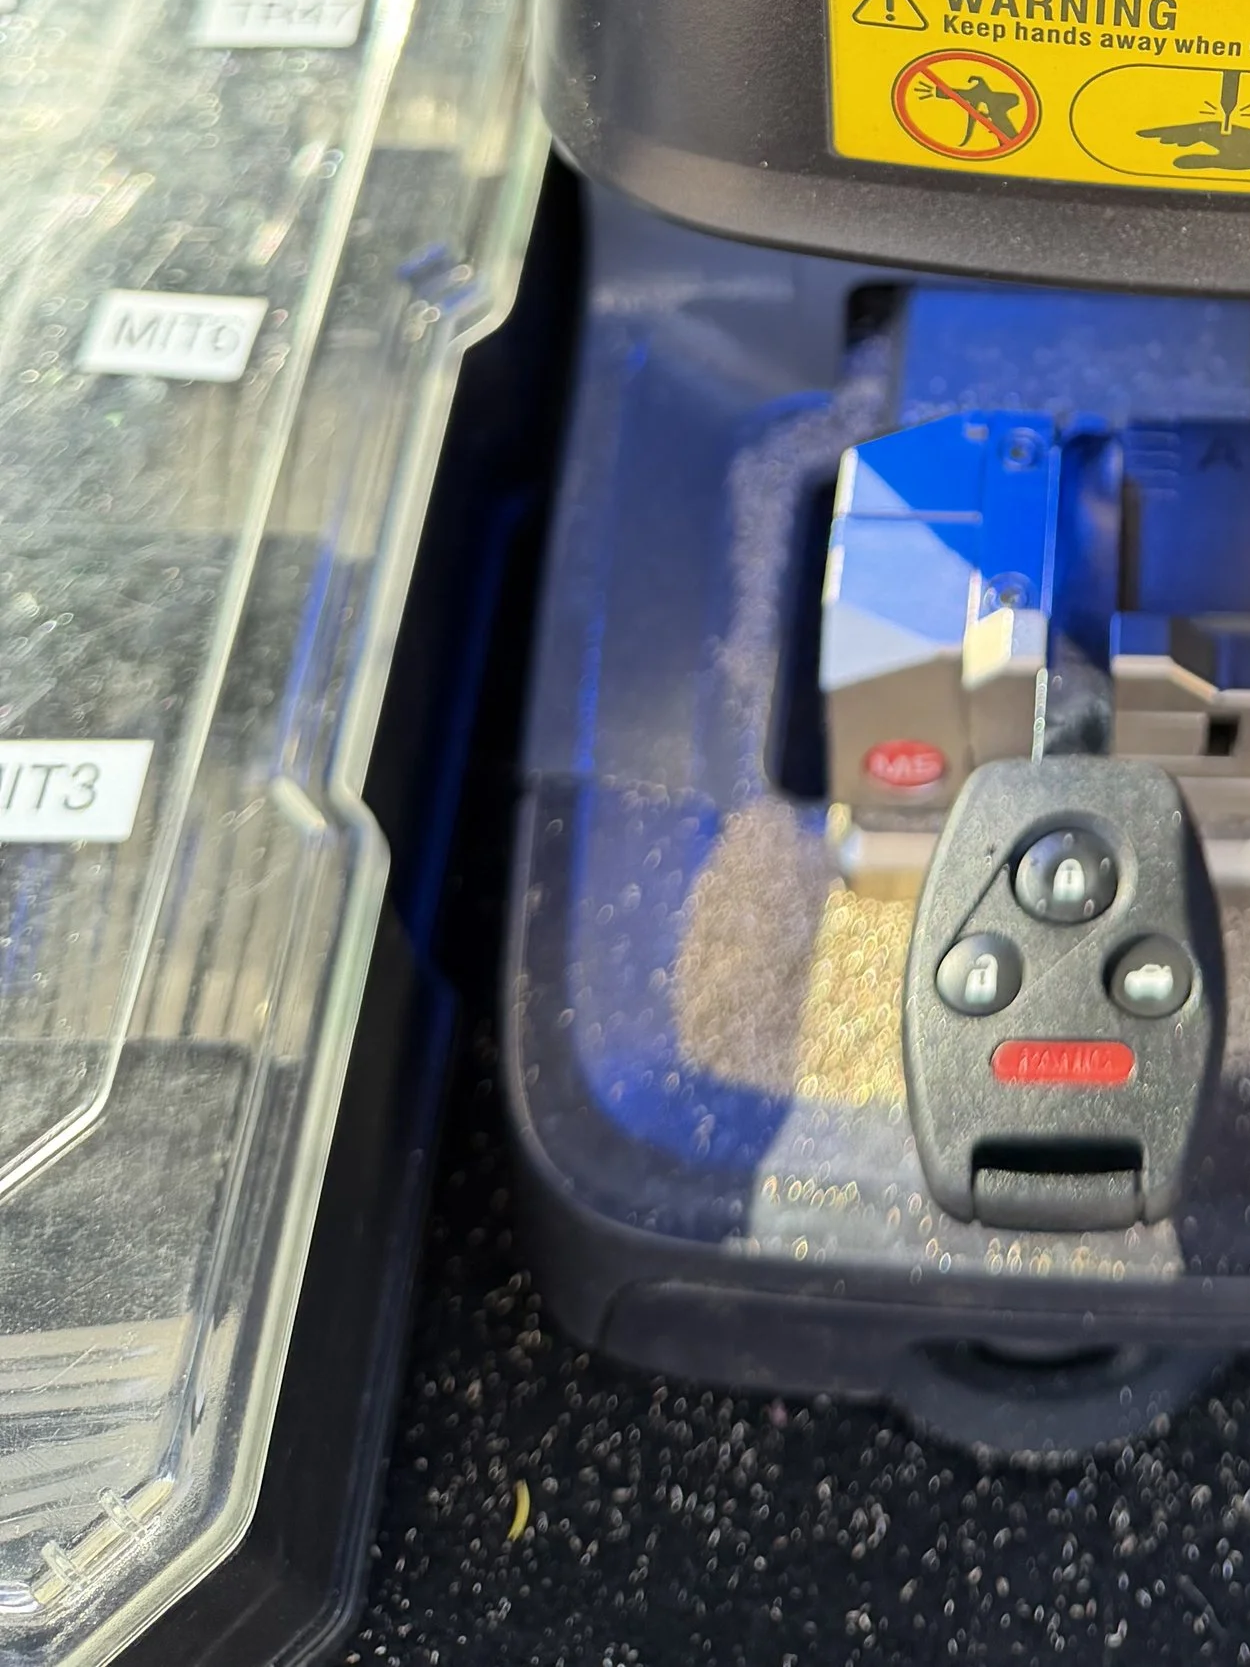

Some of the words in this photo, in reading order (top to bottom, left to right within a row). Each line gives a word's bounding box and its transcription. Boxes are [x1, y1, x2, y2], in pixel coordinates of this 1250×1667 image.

[943, 14, 1006, 42] Keep
[1015, 20, 1091, 47] hands
[1099, 32, 1168, 56] away
[1174, 36, 1241, 58] when
[0, 762, 101, 811] IT3
